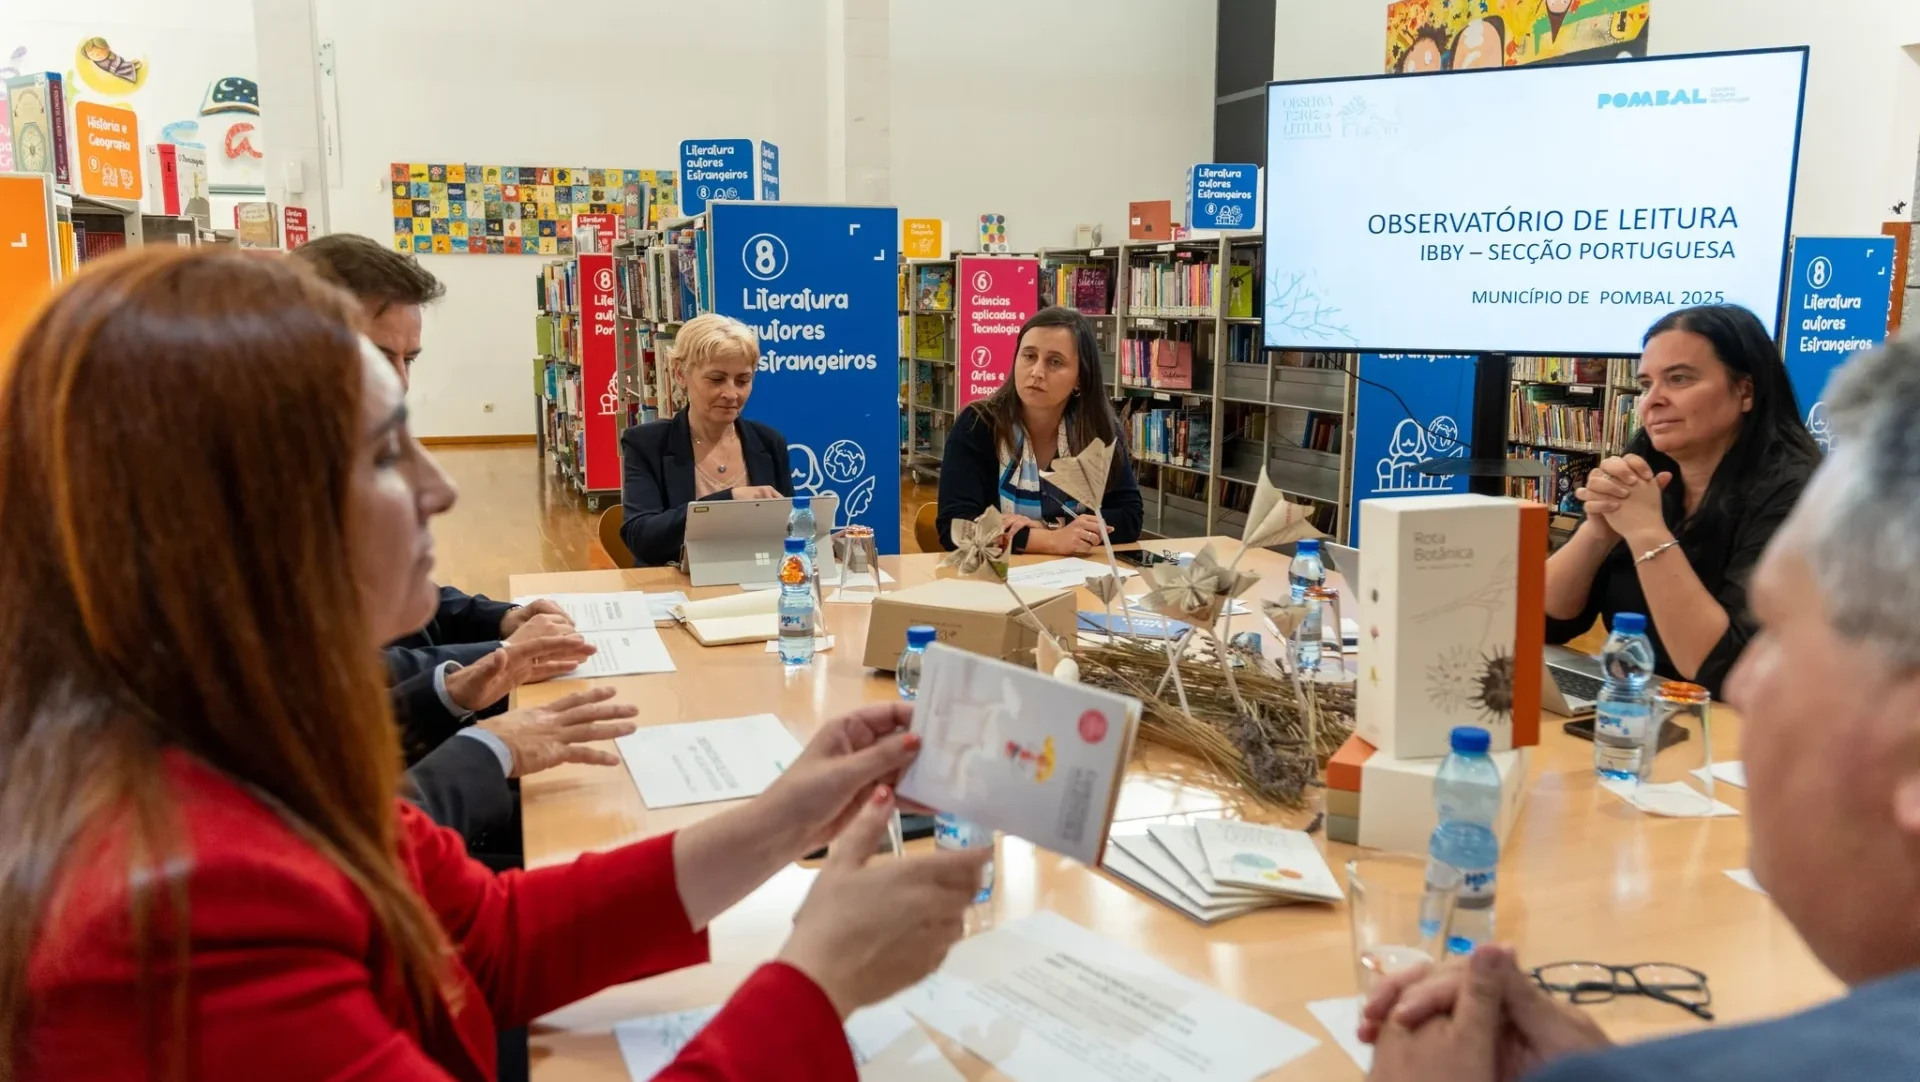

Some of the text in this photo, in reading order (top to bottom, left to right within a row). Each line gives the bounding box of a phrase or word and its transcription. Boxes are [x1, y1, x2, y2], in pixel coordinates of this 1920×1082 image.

[1597, 88, 1707, 109] POMBAL
[87, 116, 128, 133] História e
[88, 134, 131, 151] Geografia
[685, 145, 735, 156] Literatura
[90, 158, 97, 170] 9
[686, 157, 724, 169] autores
[686, 169, 749, 182] Estrangeiros
[1198, 168, 1242, 178] Literatura
[700, 187, 707, 198] 8
[1198, 179, 1232, 189] autores
[1197, 189, 1252, 200] Estrangeiros
[1367, 206, 1739, 235] OBSERVATÓRIO DE LEITURA
[755, 239, 776, 275] 8
[1420, 244, 1464, 261] IBBY
[1488, 239, 1572, 265] SECÇÃO
[1579, 241, 1736, 261] PORTUGUESA
[601, 271, 611, 288] 8
[1813, 260, 1825, 285] 8
[978, 273, 987, 290] 6
[743, 287, 849, 312] Literatura
[971, 294, 1011, 306] Ciências
[1472, 287, 1724, 305] MUNICÍPIO DE POMBAL 2025
[1803, 293, 1862, 311] Literatura
[971, 309, 1016, 322] aplicadas
[1802, 315, 1846, 332] autores
[748, 318, 826, 343] autores
[971, 322, 1021, 336] Tecnologia
[1800, 335, 1873, 354] Estrangeiros
[755, 348, 878, 375] strangeiros
[977, 349, 987, 366] 7
[971, 370, 1005, 381] Artes e
[1414, 531, 1446, 545] Rota
[1414, 546, 1474, 562] Botânica
